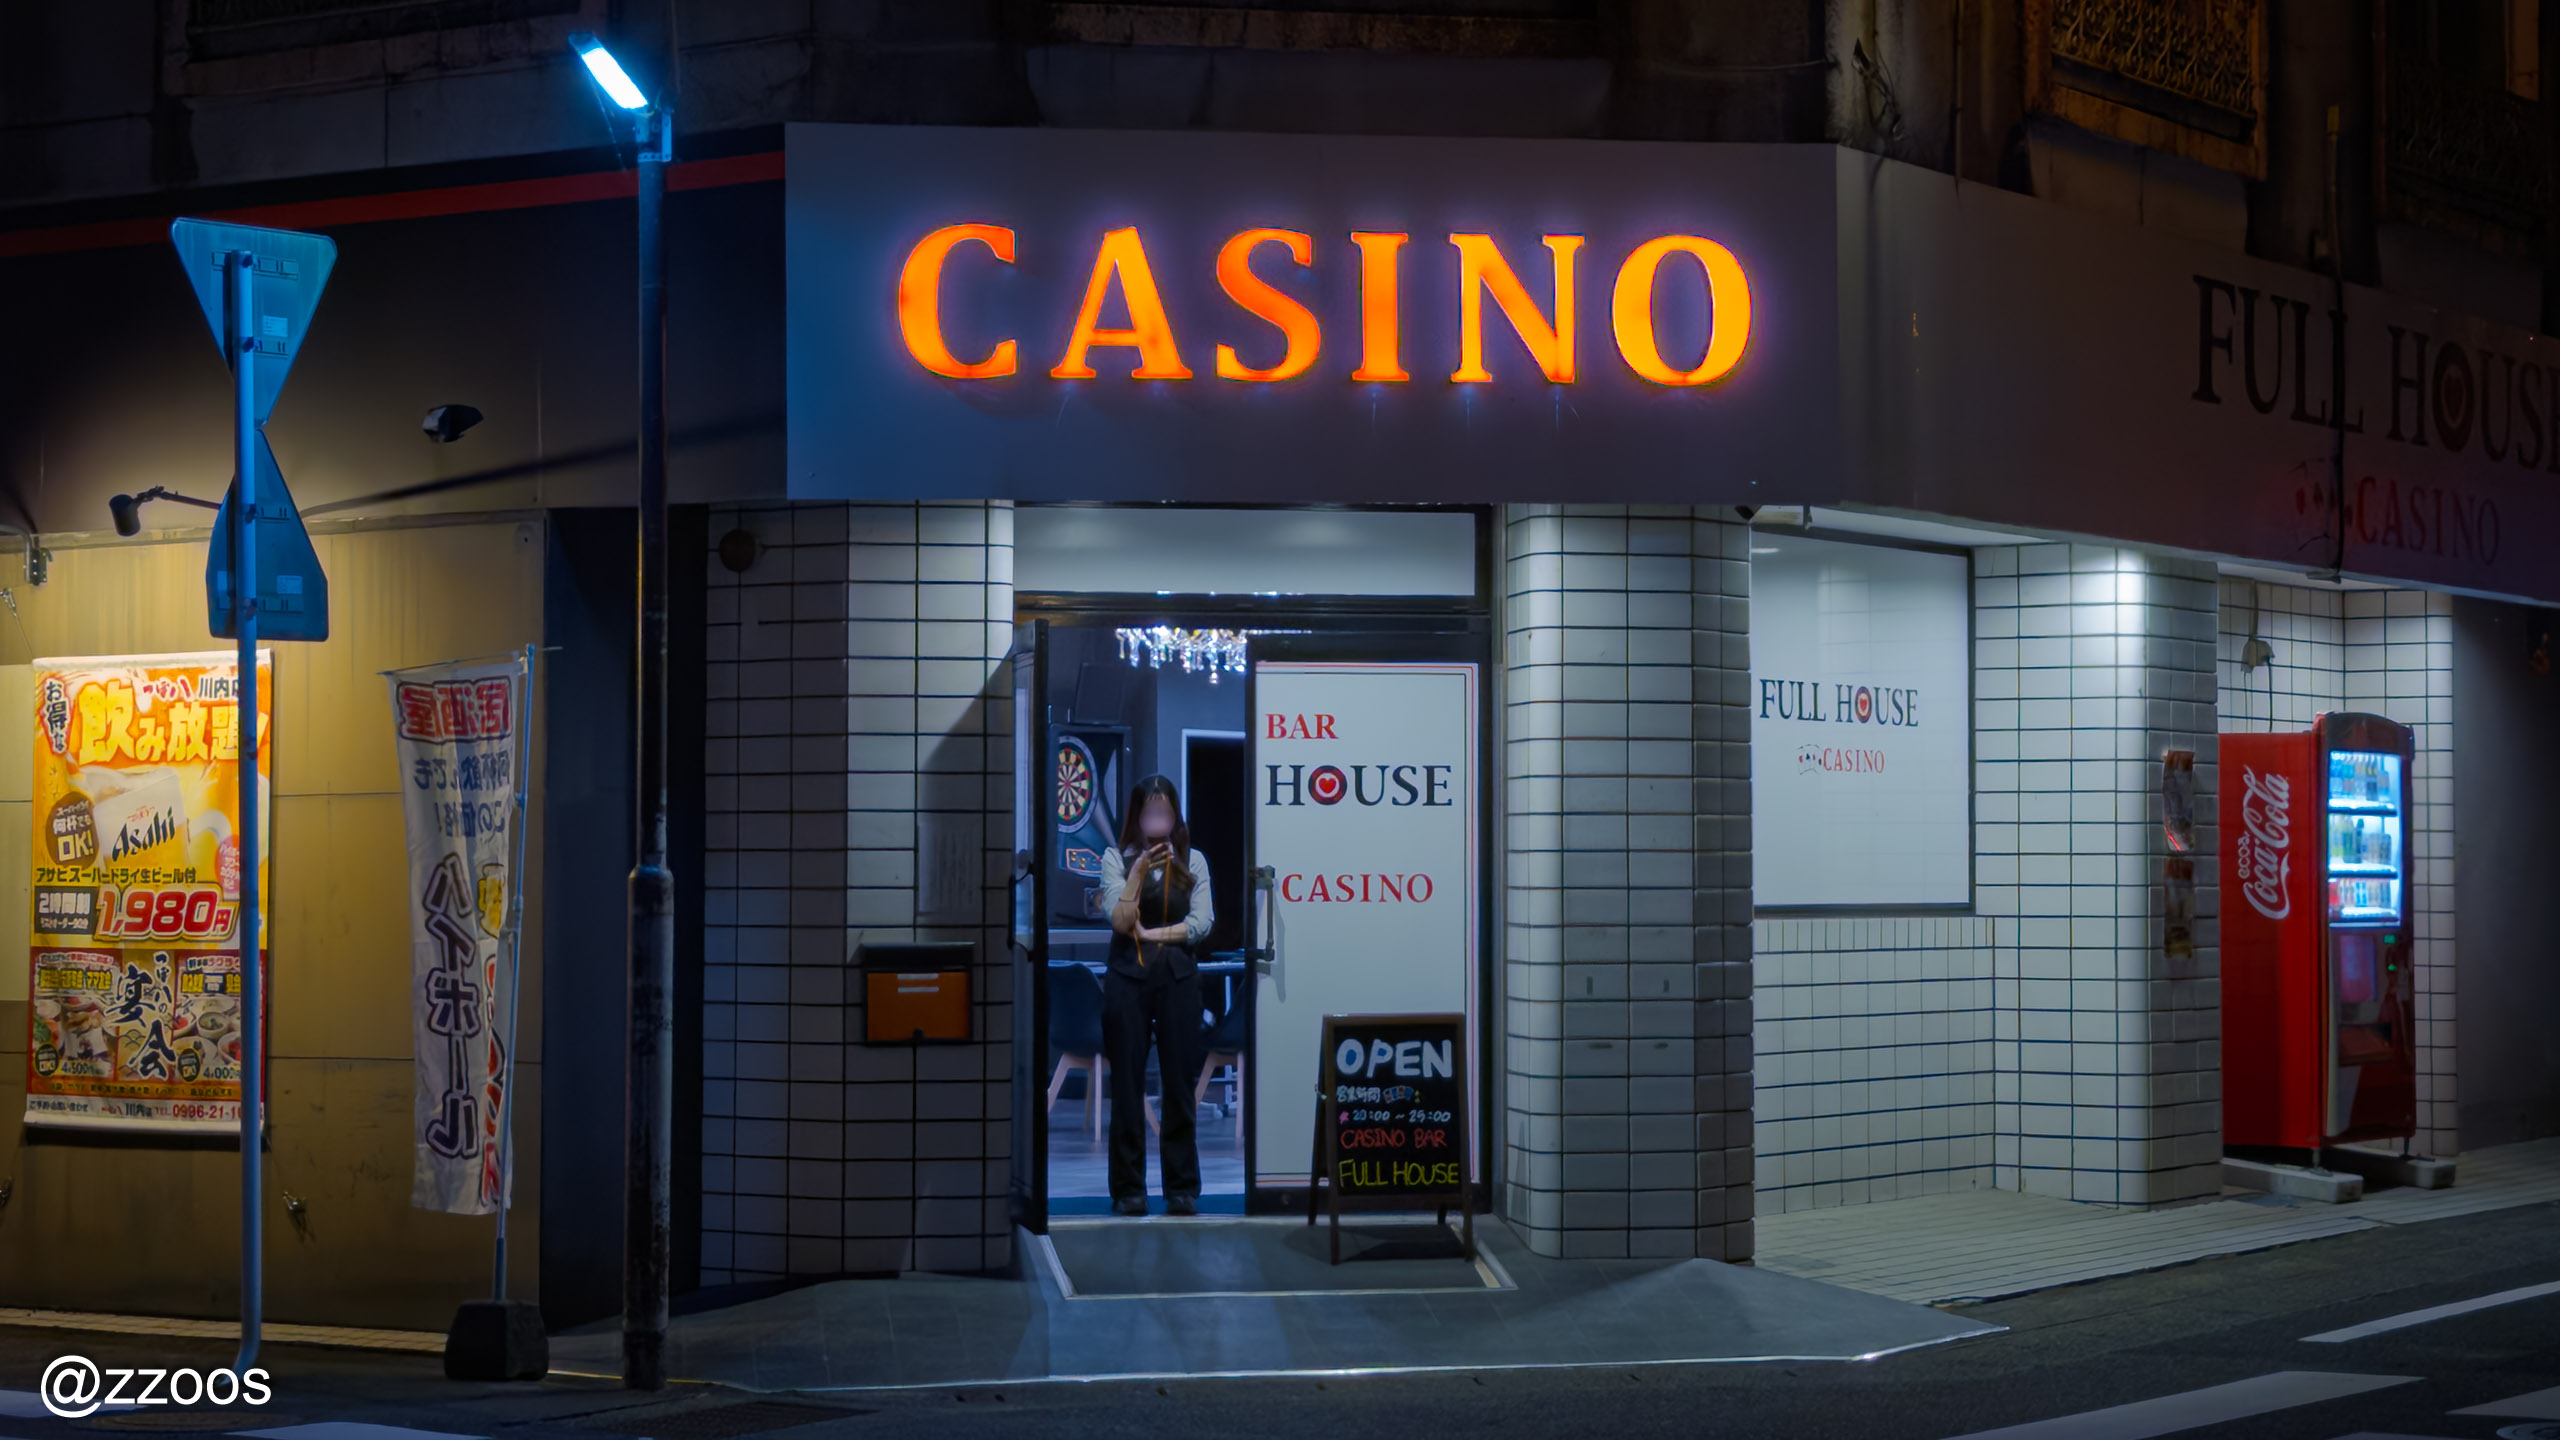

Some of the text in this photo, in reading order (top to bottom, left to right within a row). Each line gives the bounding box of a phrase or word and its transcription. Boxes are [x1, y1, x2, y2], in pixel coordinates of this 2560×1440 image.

[898, 223, 1752, 386] CASINO
[2191, 274, 2364, 433] FULL
[2357, 476, 2499, 566] CASINO
[46, 681, 67, 751] お得な
[1760, 678, 1919, 727] FULL HOUSE
[1265, 713, 1339, 739] BAR
[1823, 748, 1885, 774] CASINO
[1265, 765, 1453, 806] HOUSE
[57, 829, 94, 862] OK!
[112, 805, 176, 862] Asahi
[2243, 765, 2290, 919] Coca-Cola
[1281, 873, 1433, 903] CASINO
[103, 890, 230, 934] 1,980円
[1336, 1038, 1453, 1078] OPEN
[1340, 1127, 1448, 1149] CASINO BAR
[1339, 1158, 1460, 1188] FULL HOUSE
